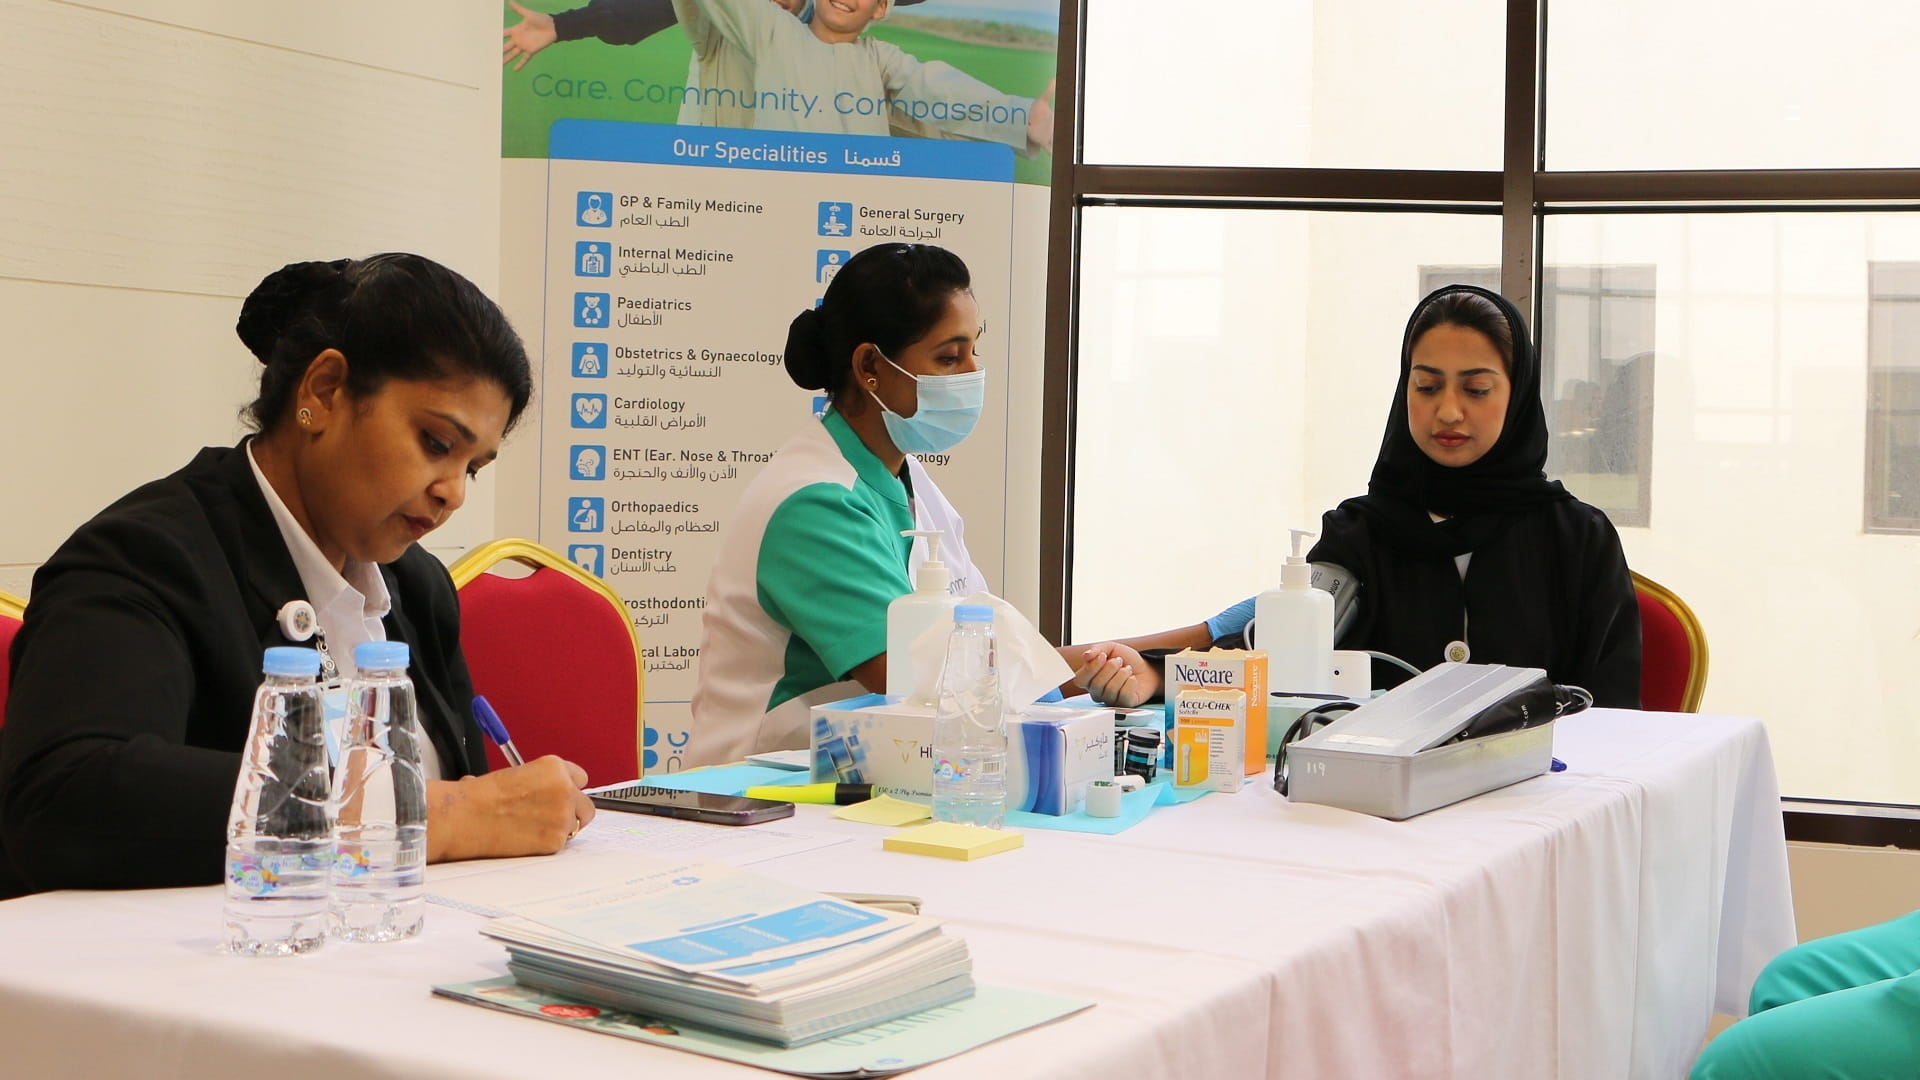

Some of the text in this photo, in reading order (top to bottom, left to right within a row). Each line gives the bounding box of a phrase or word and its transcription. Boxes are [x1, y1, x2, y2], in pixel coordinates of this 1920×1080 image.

[533, 73, 612, 100] Care.
[624, 78, 822, 118] Community.
[673, 139, 827, 165] Our Specialities
[844, 149, 901, 167] قسمنا
[619, 195, 763, 214] GP & Family Medicine
[619, 213, 689, 228] الطب العام
[859, 206, 965, 224] General Surgery
[859, 224, 941, 240] الجراحة العامة
[618, 246, 734, 263] Internal Medicine
[618, 262, 706, 278] الطب الباطني
[617, 297, 692, 311] Paediatrics
[617, 311, 662, 328] الأطفال
[615, 346, 783, 366] Obstetrics & Gynaecology
[616, 364, 721, 379] النسائية والتوليد
[614, 397, 686, 412] Cardiology
[614, 413, 706, 430] الأمراض القلبية
[613, 448, 641, 461] ENT
[680, 449, 713, 462] Nose
[717, 450, 727, 462] &
[913, 453, 951, 466] ology
[613, 466, 737, 482] الأذن والأنف والحنجرة
[611, 501, 699, 515] Orthopaedics
[610, 520, 720, 535] العظام والمفاصل
[611, 548, 673, 561] Dentistry
[653, 561, 677, 573] طب
[623, 597, 706, 610] rosthodonti
[634, 613, 669, 628] التركي
[641, 646, 700, 658] cal Labor
[648, 659, 690, 673] المختبر
[1175, 664, 1233, 687] Nexcare
[920, 744, 932, 759] Hi
